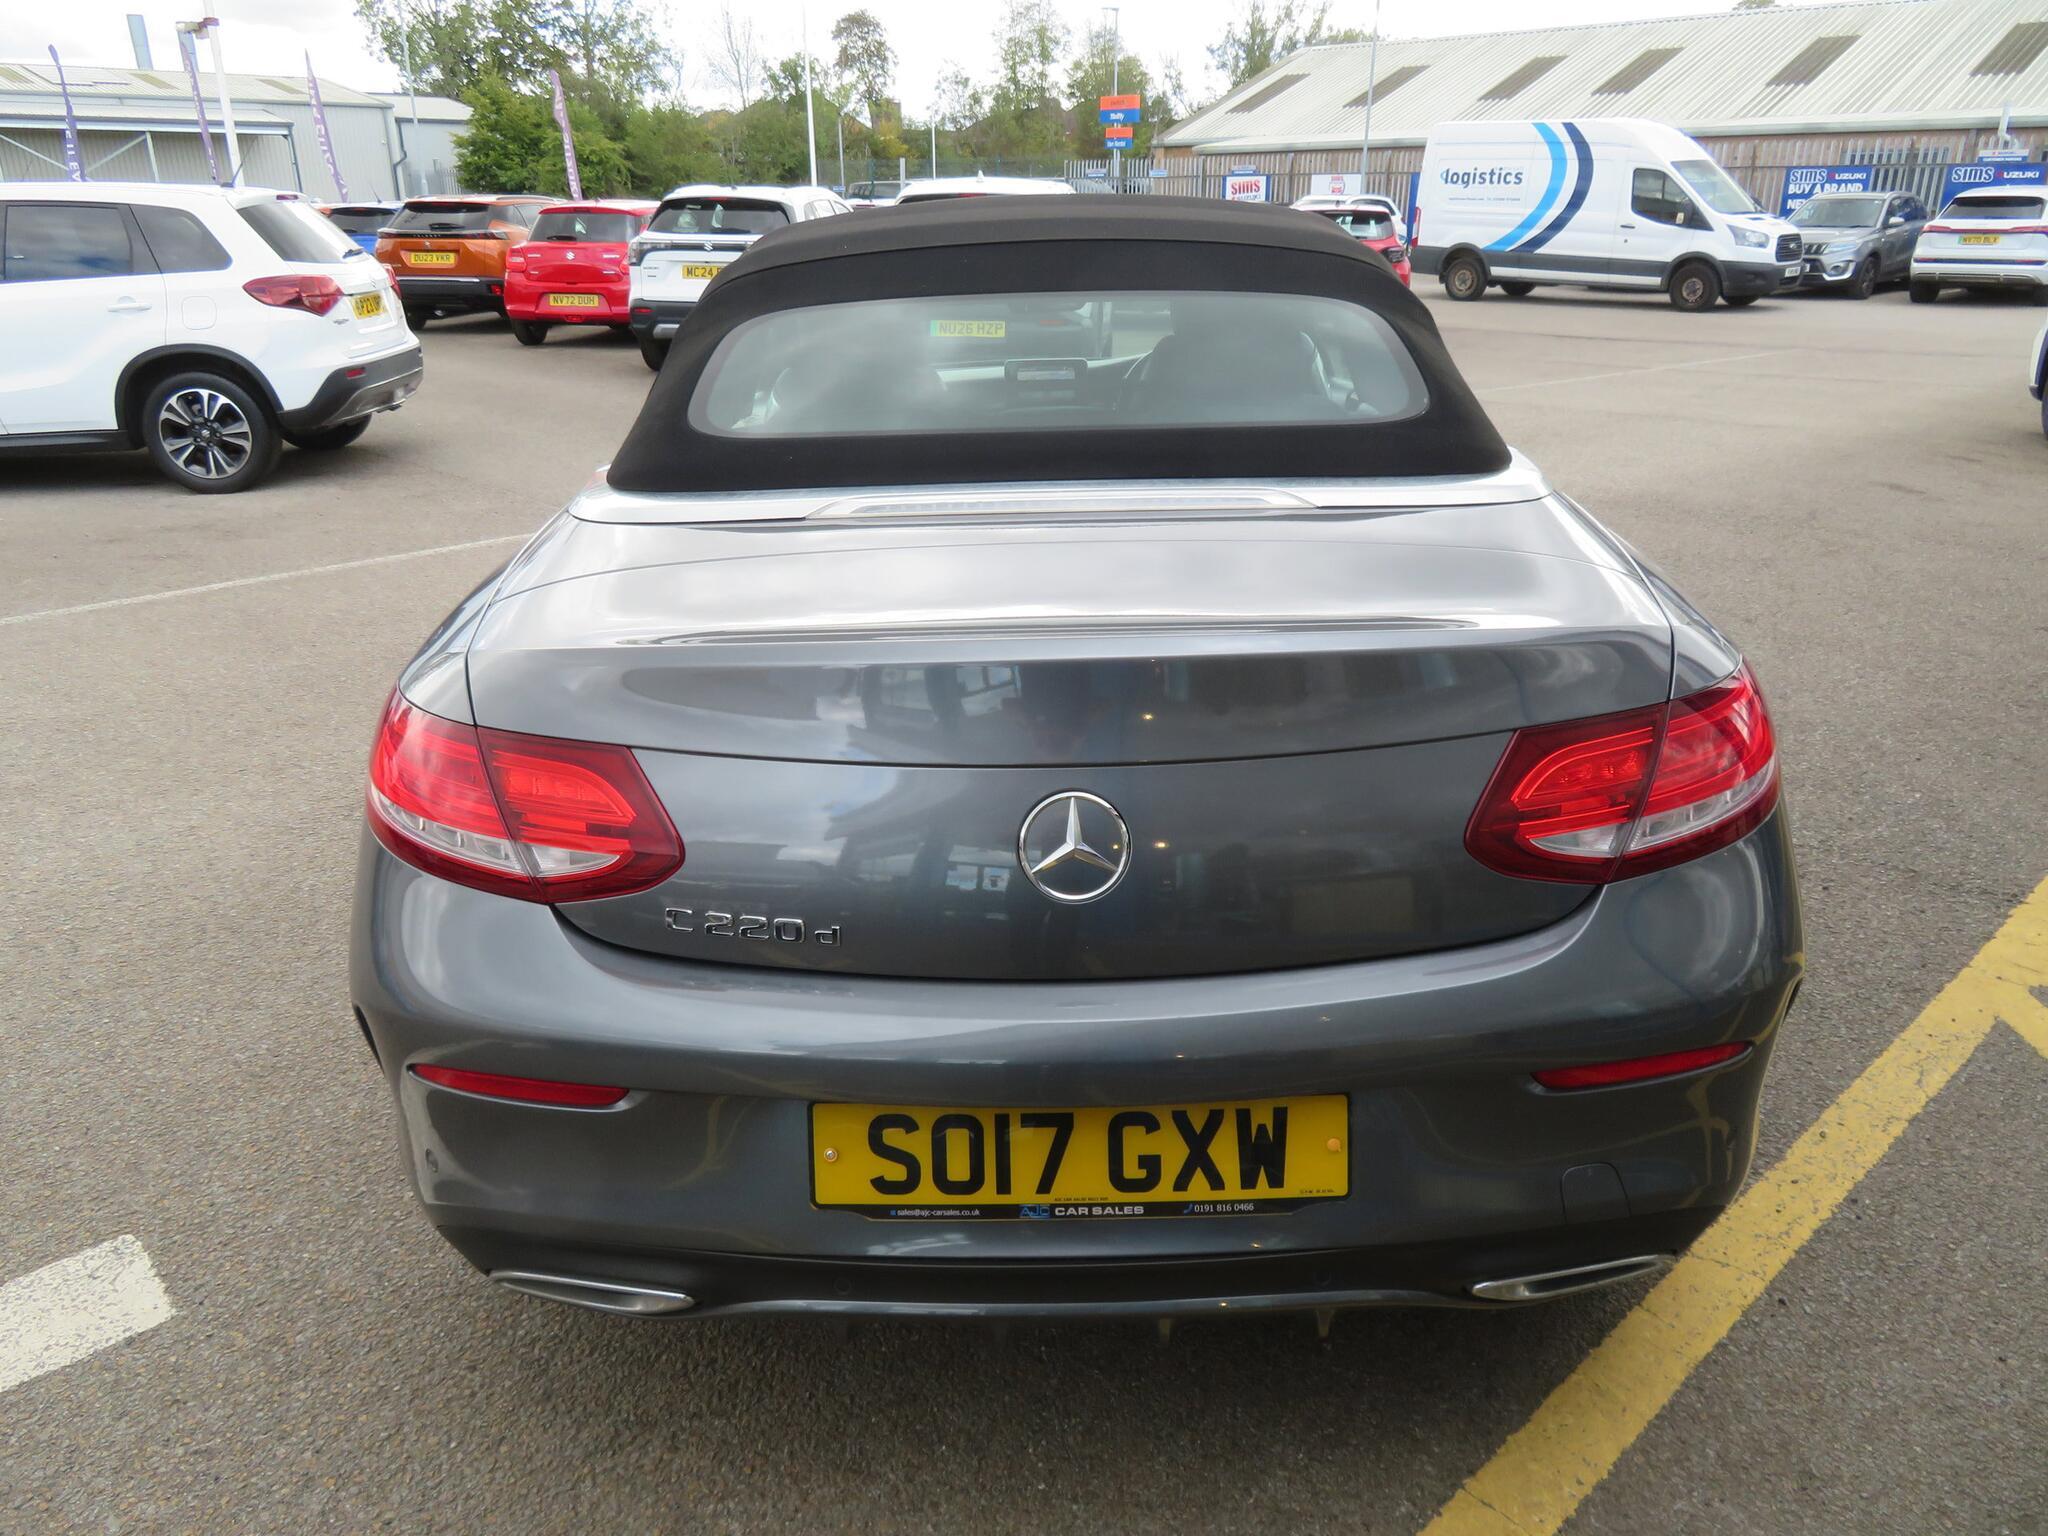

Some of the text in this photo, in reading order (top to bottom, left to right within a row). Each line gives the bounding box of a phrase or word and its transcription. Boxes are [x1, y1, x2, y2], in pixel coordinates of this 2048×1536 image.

[1444, 166, 1523, 189] logistics
[1788, 182, 1863, 194] BUY A BRAND
[686, 266, 713, 278] MC24
[553, 295, 595, 305] NV72 DUH
[665, 907, 841, 947] C 220 d
[867, 1106, 1288, 1195] SO17 GXW
[897, 1208, 980, 1218] sales@ajc-carsales.co.uk
[1020, 1204, 1145, 1218] AJC CAR SALES
[1194, 1202, 1255, 1213] 0191 816 0466
